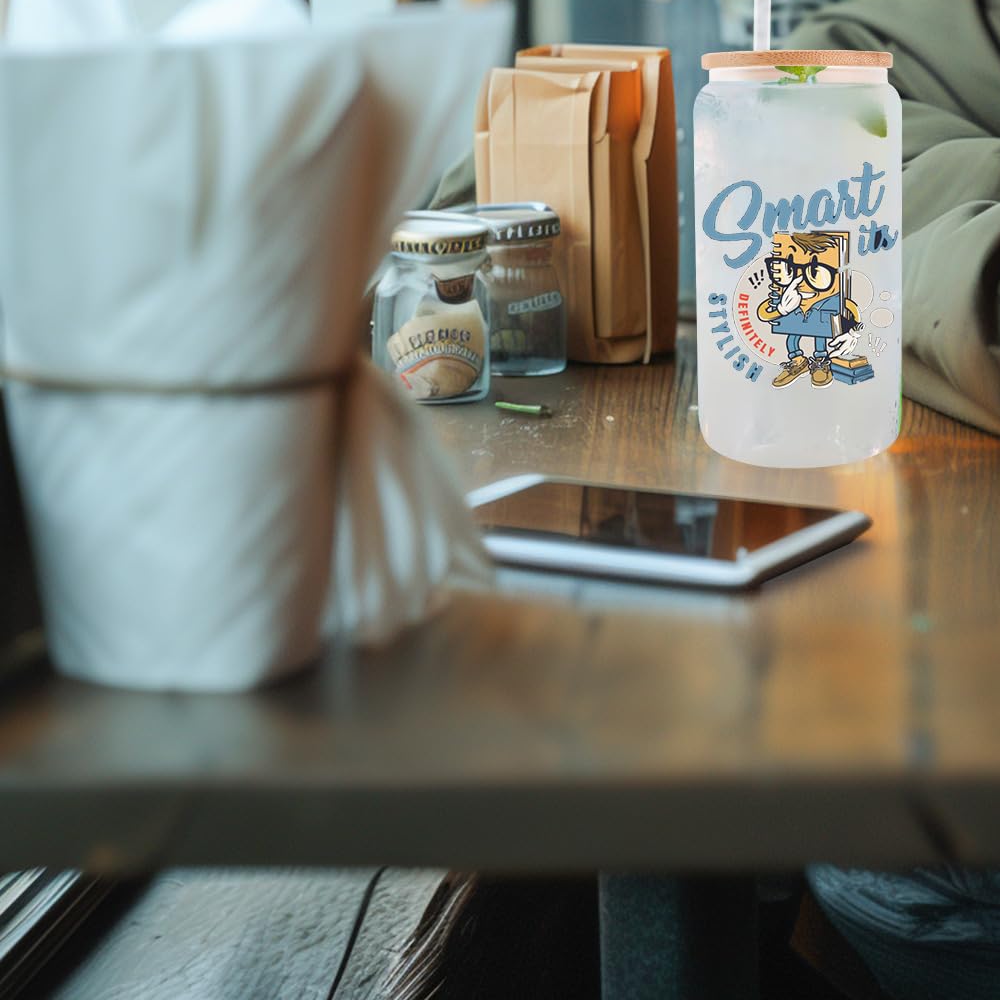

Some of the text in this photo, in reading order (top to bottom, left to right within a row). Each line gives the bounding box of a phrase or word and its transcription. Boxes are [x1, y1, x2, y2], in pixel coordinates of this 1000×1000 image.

[703, 162, 885, 269] Smart
[708, 293, 763, 382] STYLISH
[738, 293, 775, 357] DEFINITELY
